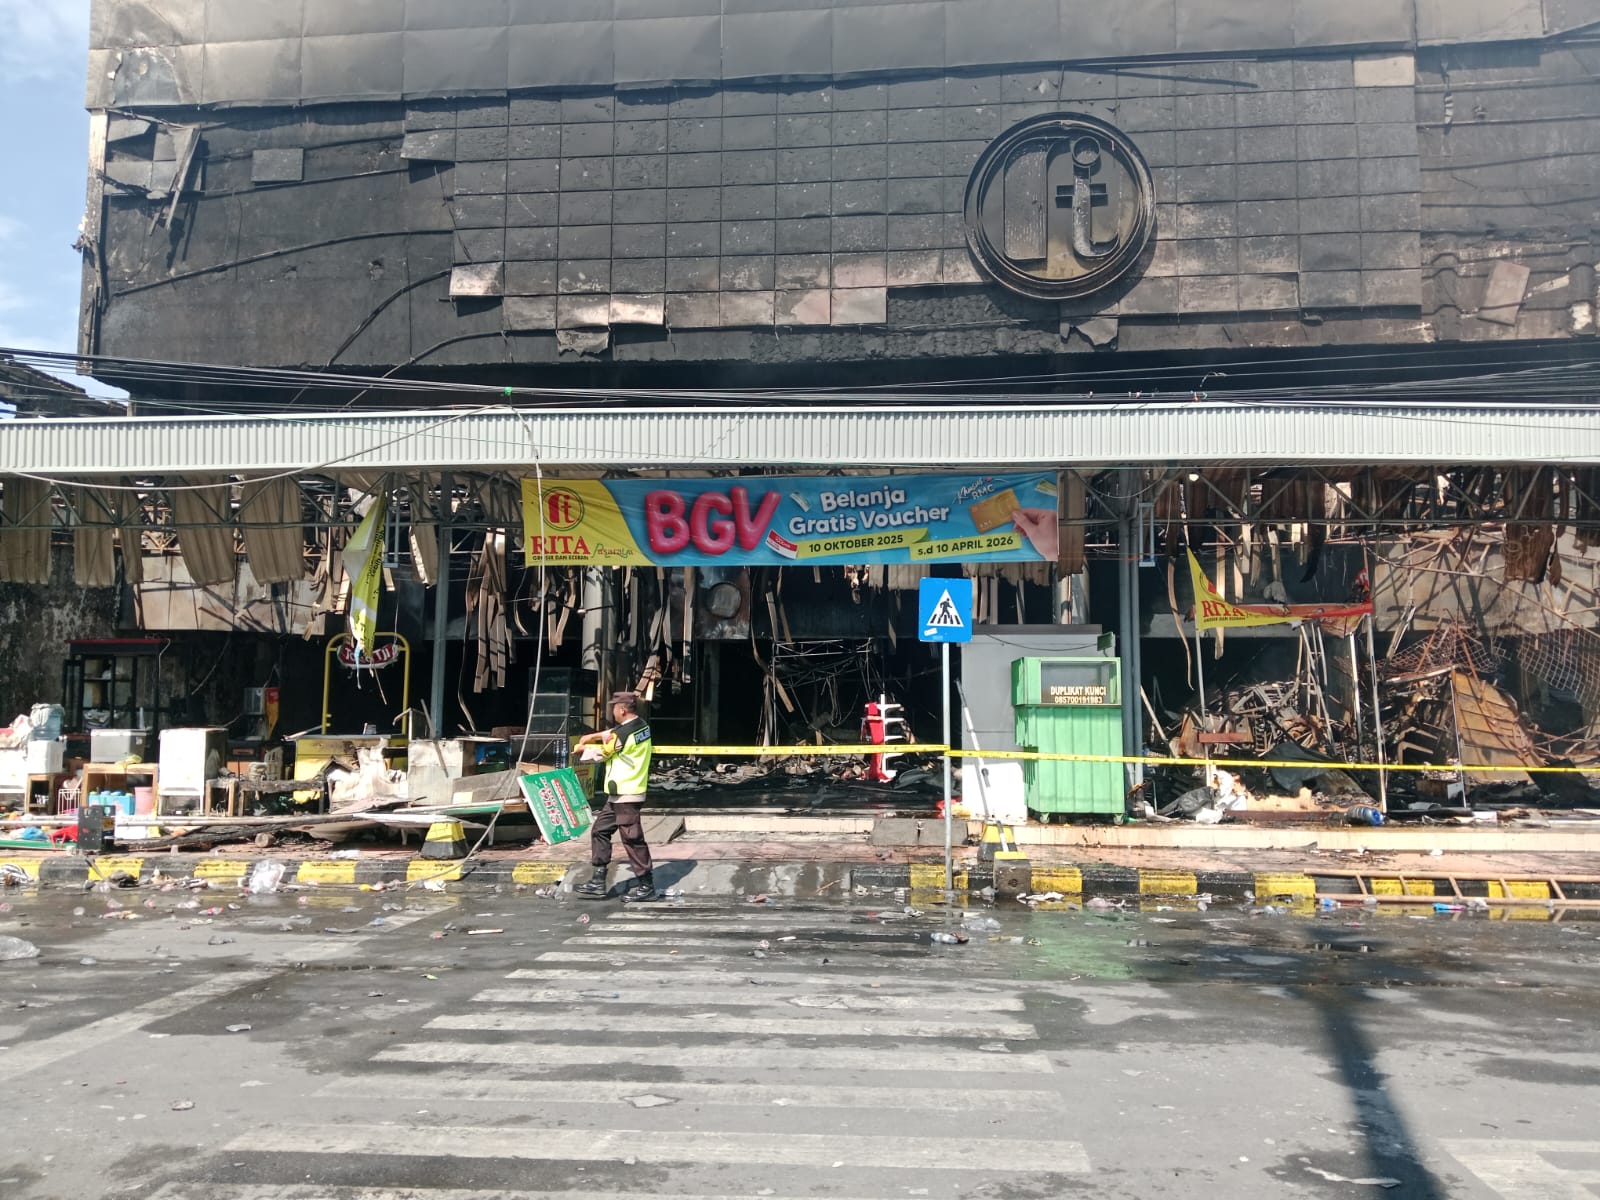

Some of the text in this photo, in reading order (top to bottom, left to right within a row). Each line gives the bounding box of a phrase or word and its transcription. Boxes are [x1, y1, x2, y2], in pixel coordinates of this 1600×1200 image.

[819, 486, 905, 513] Belanja
[971, 483, 995, 501] RMC
[644, 485, 782, 556] BGV
[788, 505, 950, 536] Gratis Voucher
[530, 535, 591, 556] RITA
[808, 534, 904, 553] 10 OKTOBER 2025
[917, 535, 1014, 556] s.d 10 APRIL 2026
[1050, 685, 1107, 696] DUPLIKAT KUNCI
